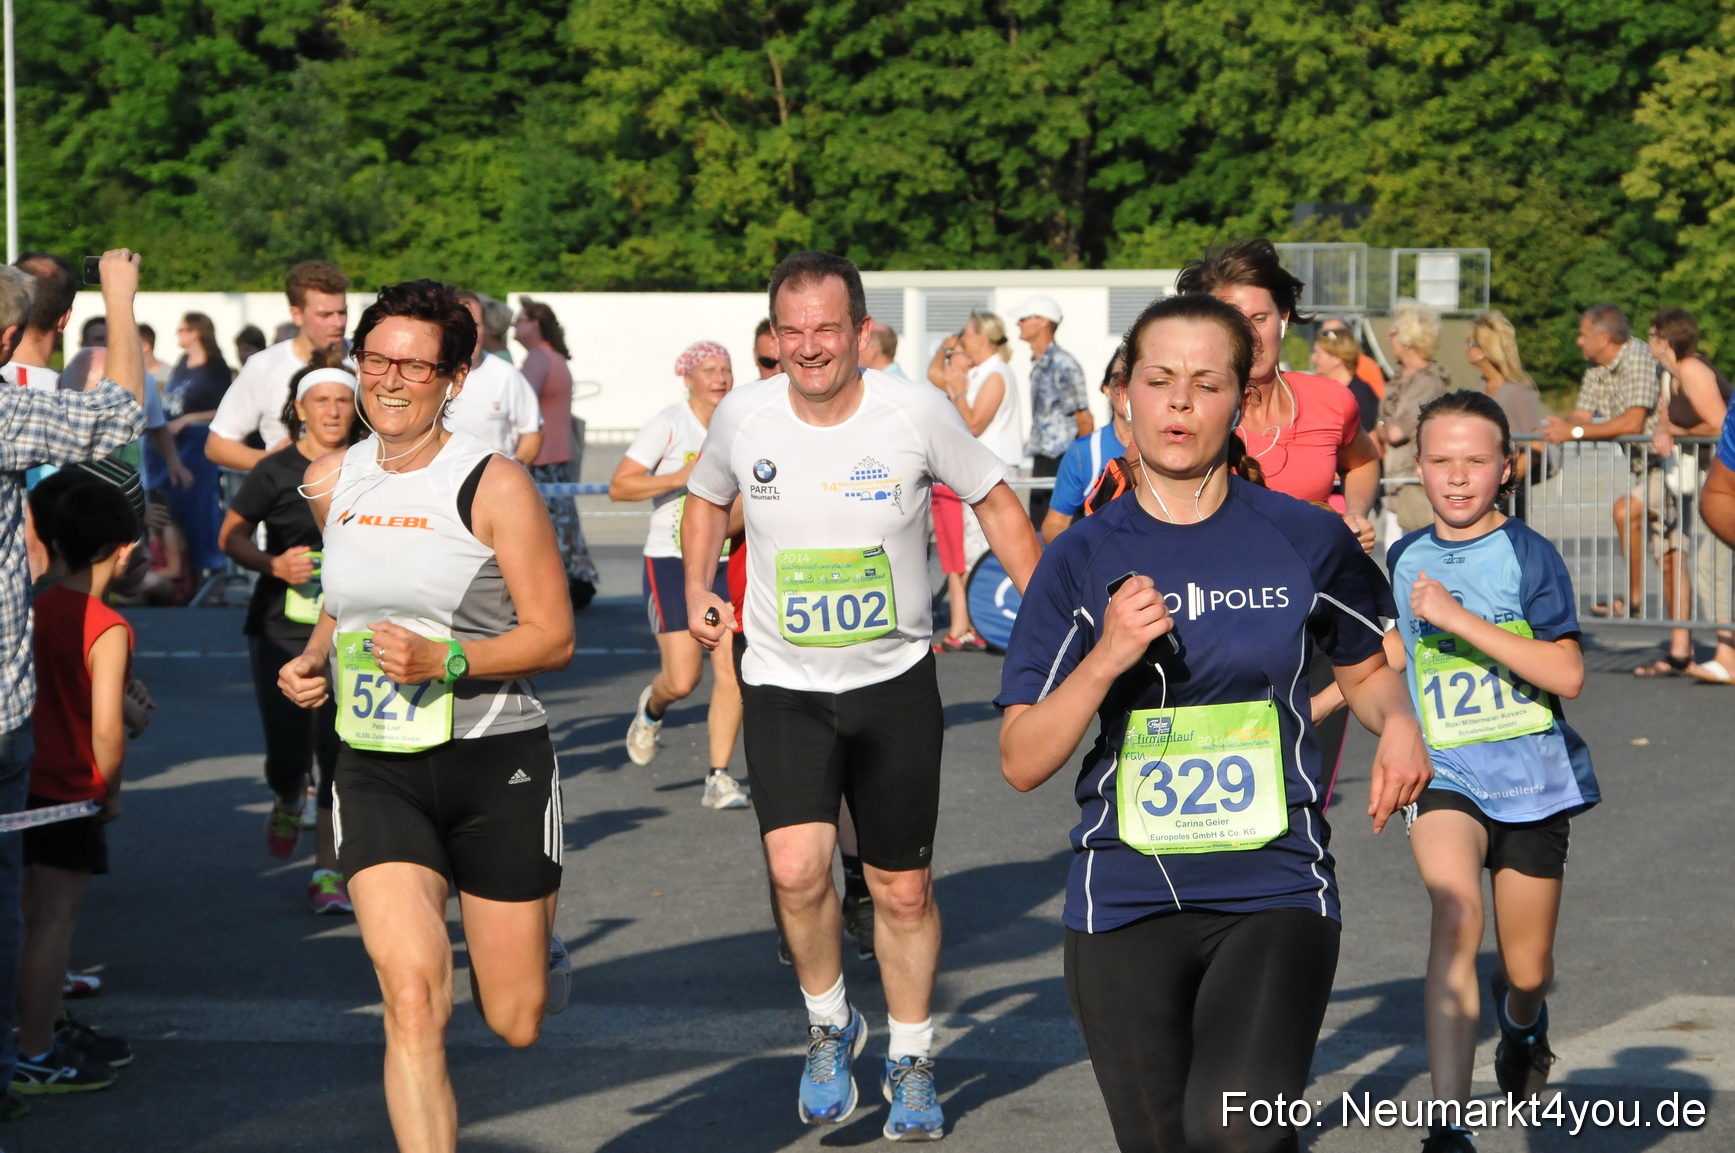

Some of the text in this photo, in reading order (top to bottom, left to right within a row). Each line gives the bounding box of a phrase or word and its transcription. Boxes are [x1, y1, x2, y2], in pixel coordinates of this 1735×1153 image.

[750, 485, 780, 494] PARTL
[357, 515, 435, 531] KLEBL
[781, 553, 810, 563] 2014
[1210, 587, 1289, 610] POLES
[785, 591, 889, 634] 5102
[352, 674, 431, 722] 527
[1424, 666, 1540, 720] 1218
[1445, 709, 1527, 729] Rosi Mittermeier-Kovacs
[1458, 721, 1517, 737] Schabmüller GmbH
[1137, 730, 1194, 745] firmenlauf
[508, 776, 531, 785] adidas
[1139, 755, 1256, 817] 329
[1175, 817, 1229, 828] Carina Geier
[1150, 833, 1190, 842] Europoles
[1192, 832, 1217, 840] GmbH
[1227, 829, 1241, 837] Co.
[1243, 828, 1256, 836] KG
